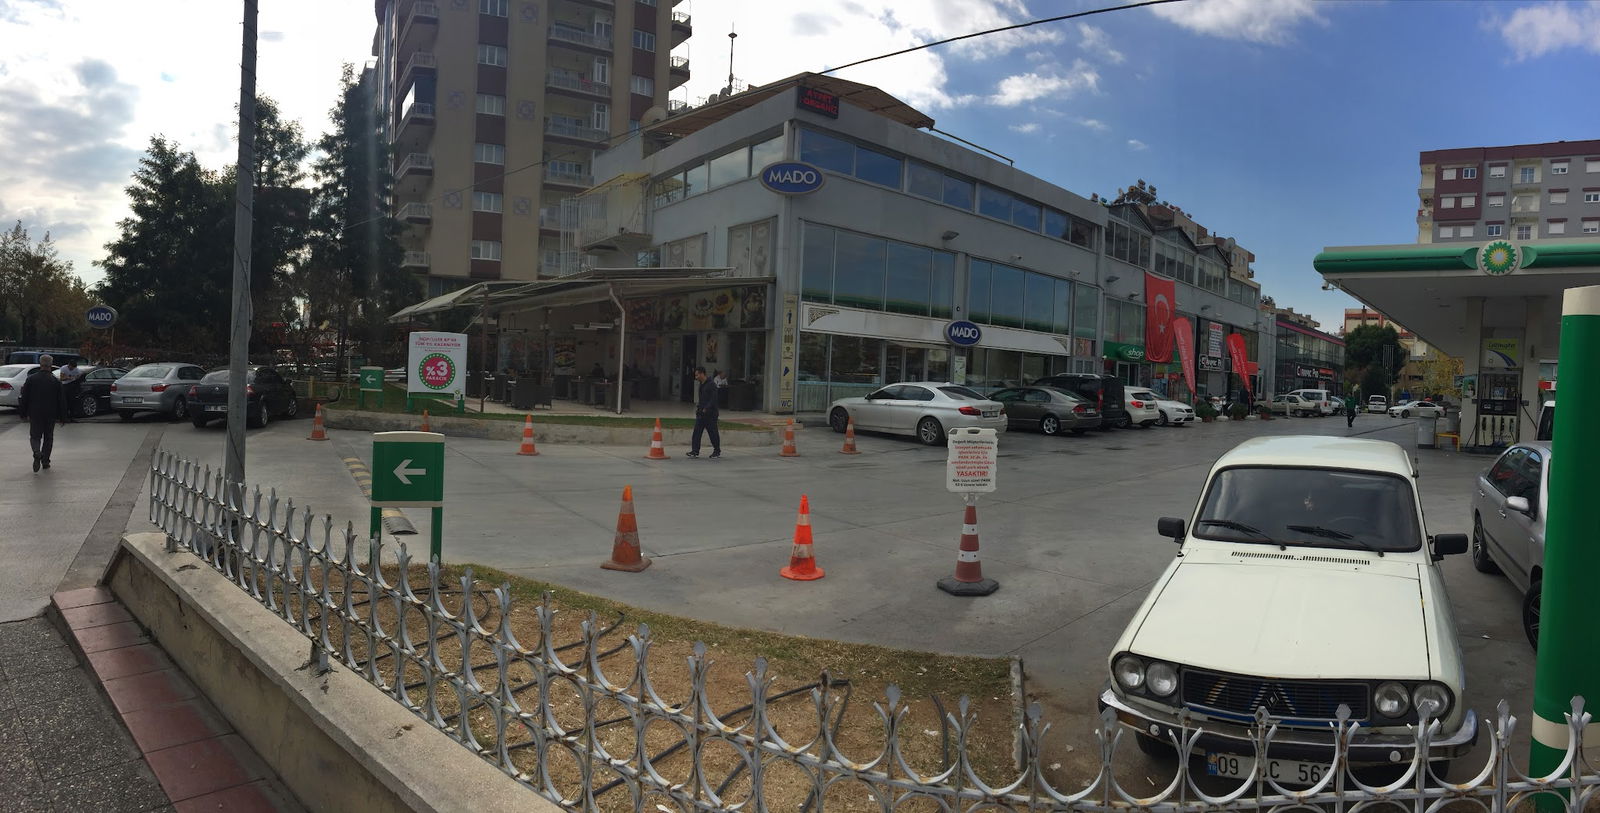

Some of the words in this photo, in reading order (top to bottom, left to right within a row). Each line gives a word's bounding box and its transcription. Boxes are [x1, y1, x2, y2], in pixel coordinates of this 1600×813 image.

[768, 170, 816, 184] MADO
[88, 312, 112, 321] MADO
[951, 326, 979, 339] MADO
[1127, 348, 1144, 357] shop
[425, 361, 449, 377] %3
[1218, 756, 1239, 775] 09
